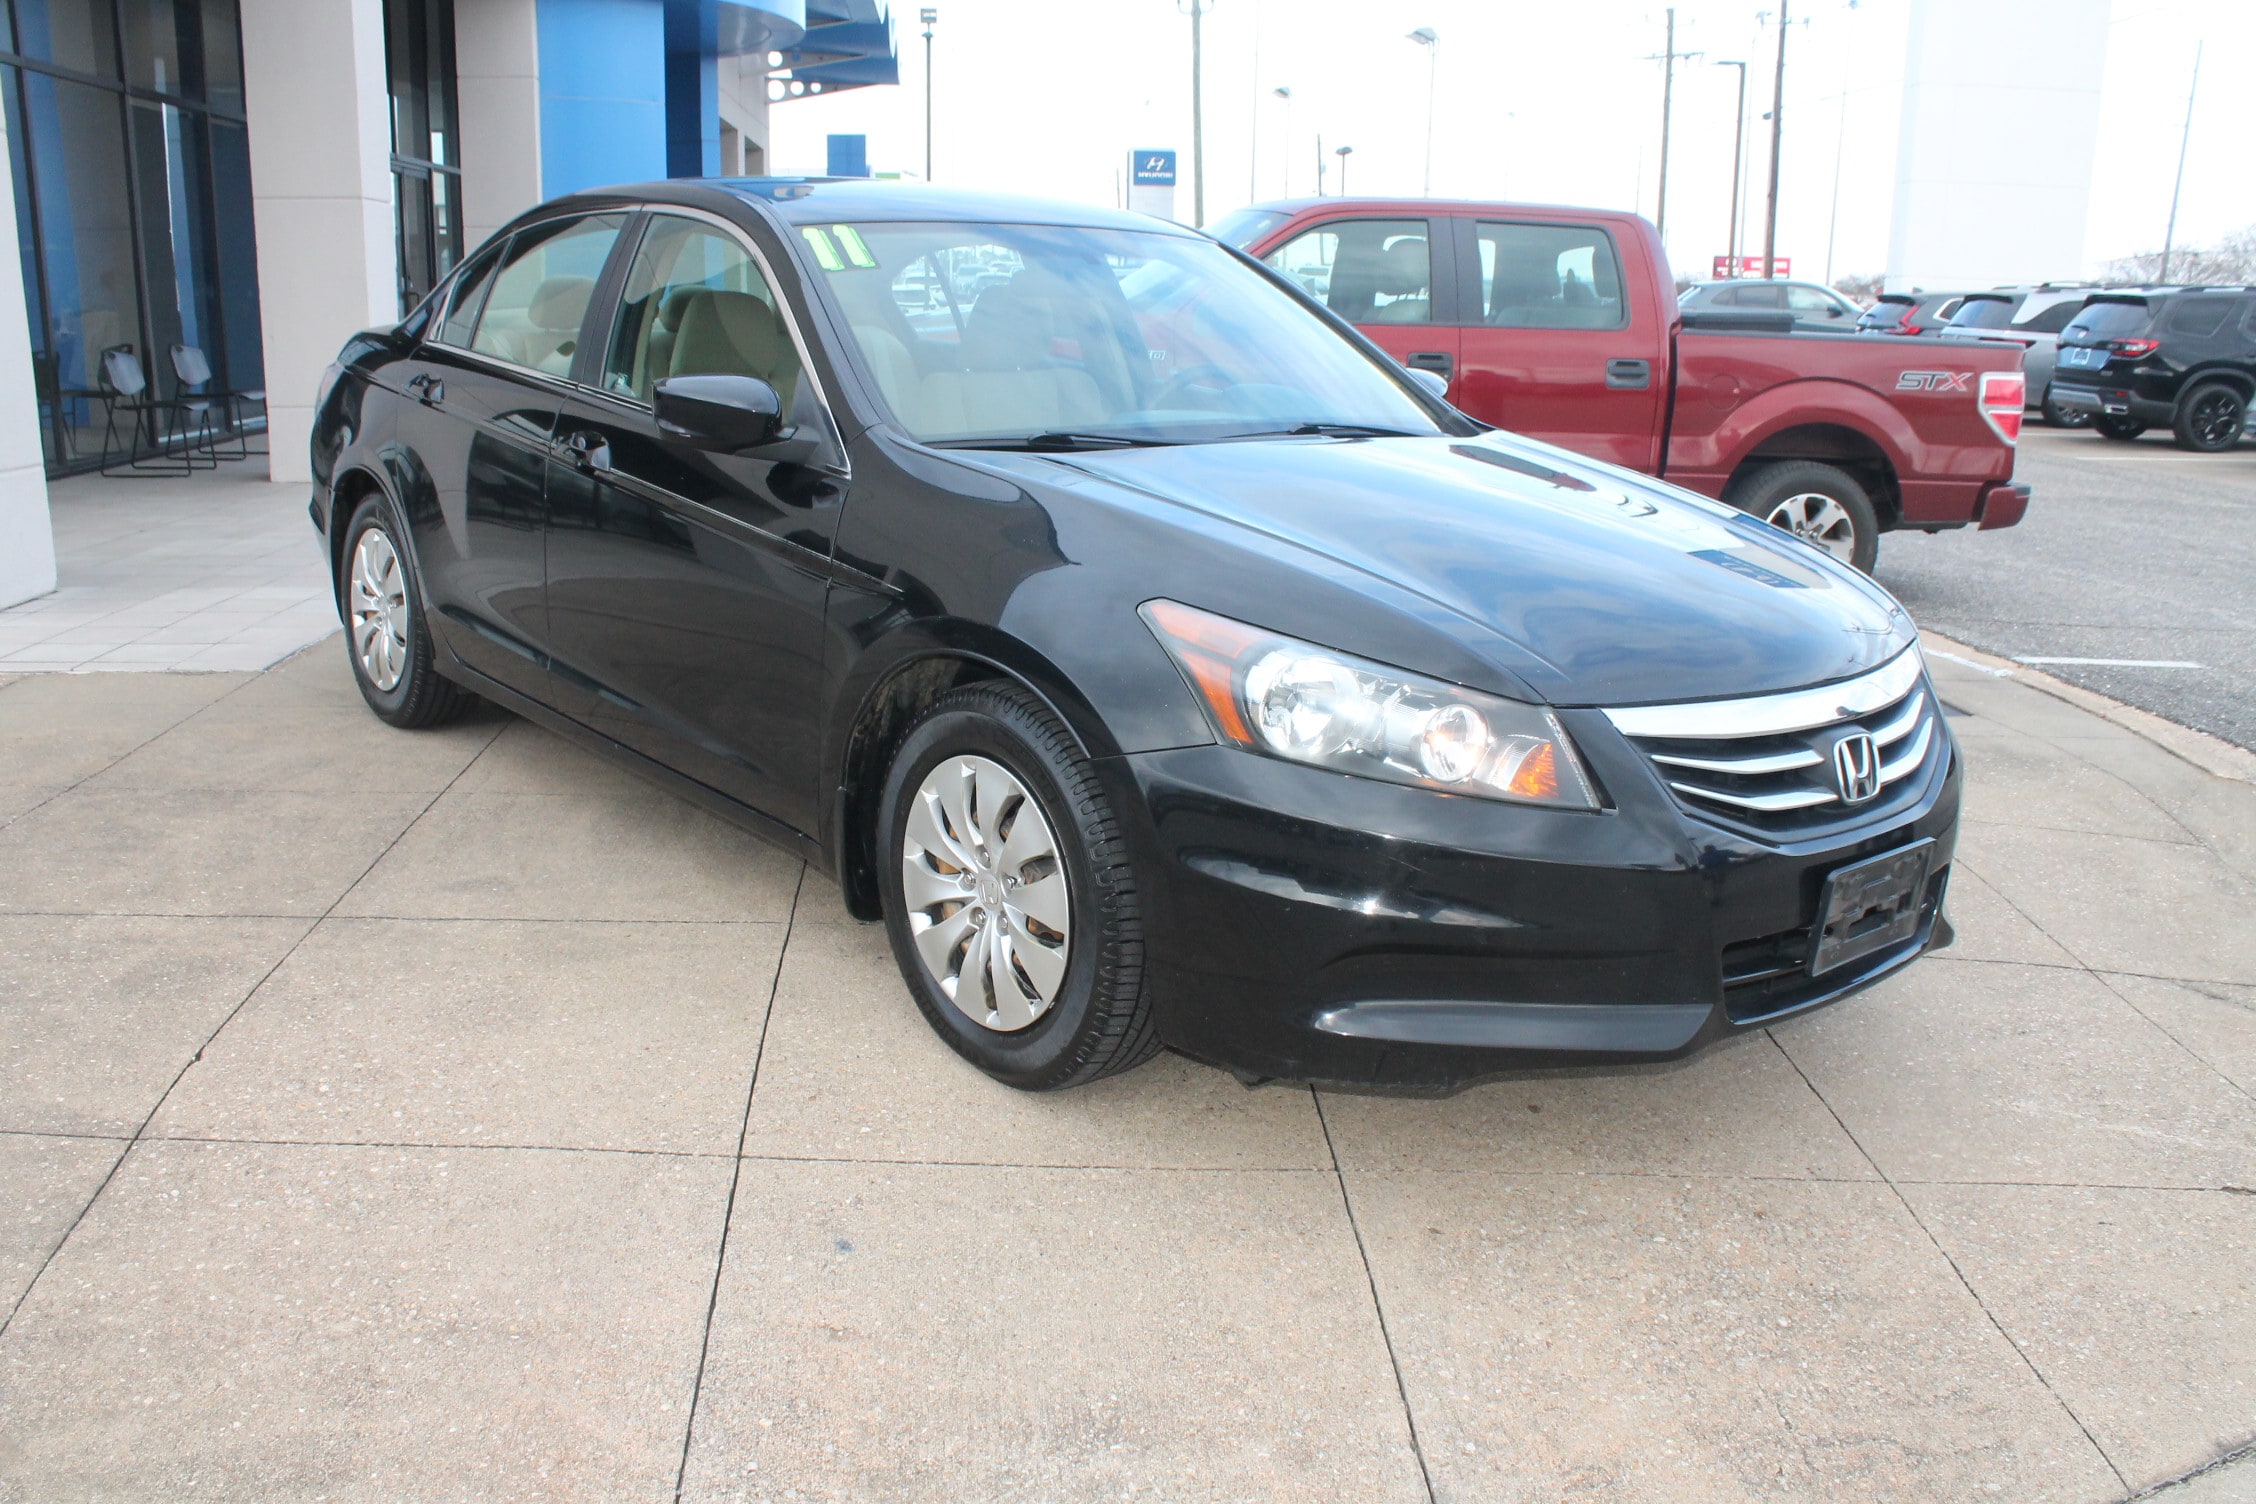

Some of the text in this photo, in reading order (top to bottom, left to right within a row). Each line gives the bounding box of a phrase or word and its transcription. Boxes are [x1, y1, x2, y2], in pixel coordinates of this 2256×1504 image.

[1137, 171, 1174, 179] HYUNDAI
[801, 224, 876, 271] 11
[1895, 370, 1974, 391] STX
